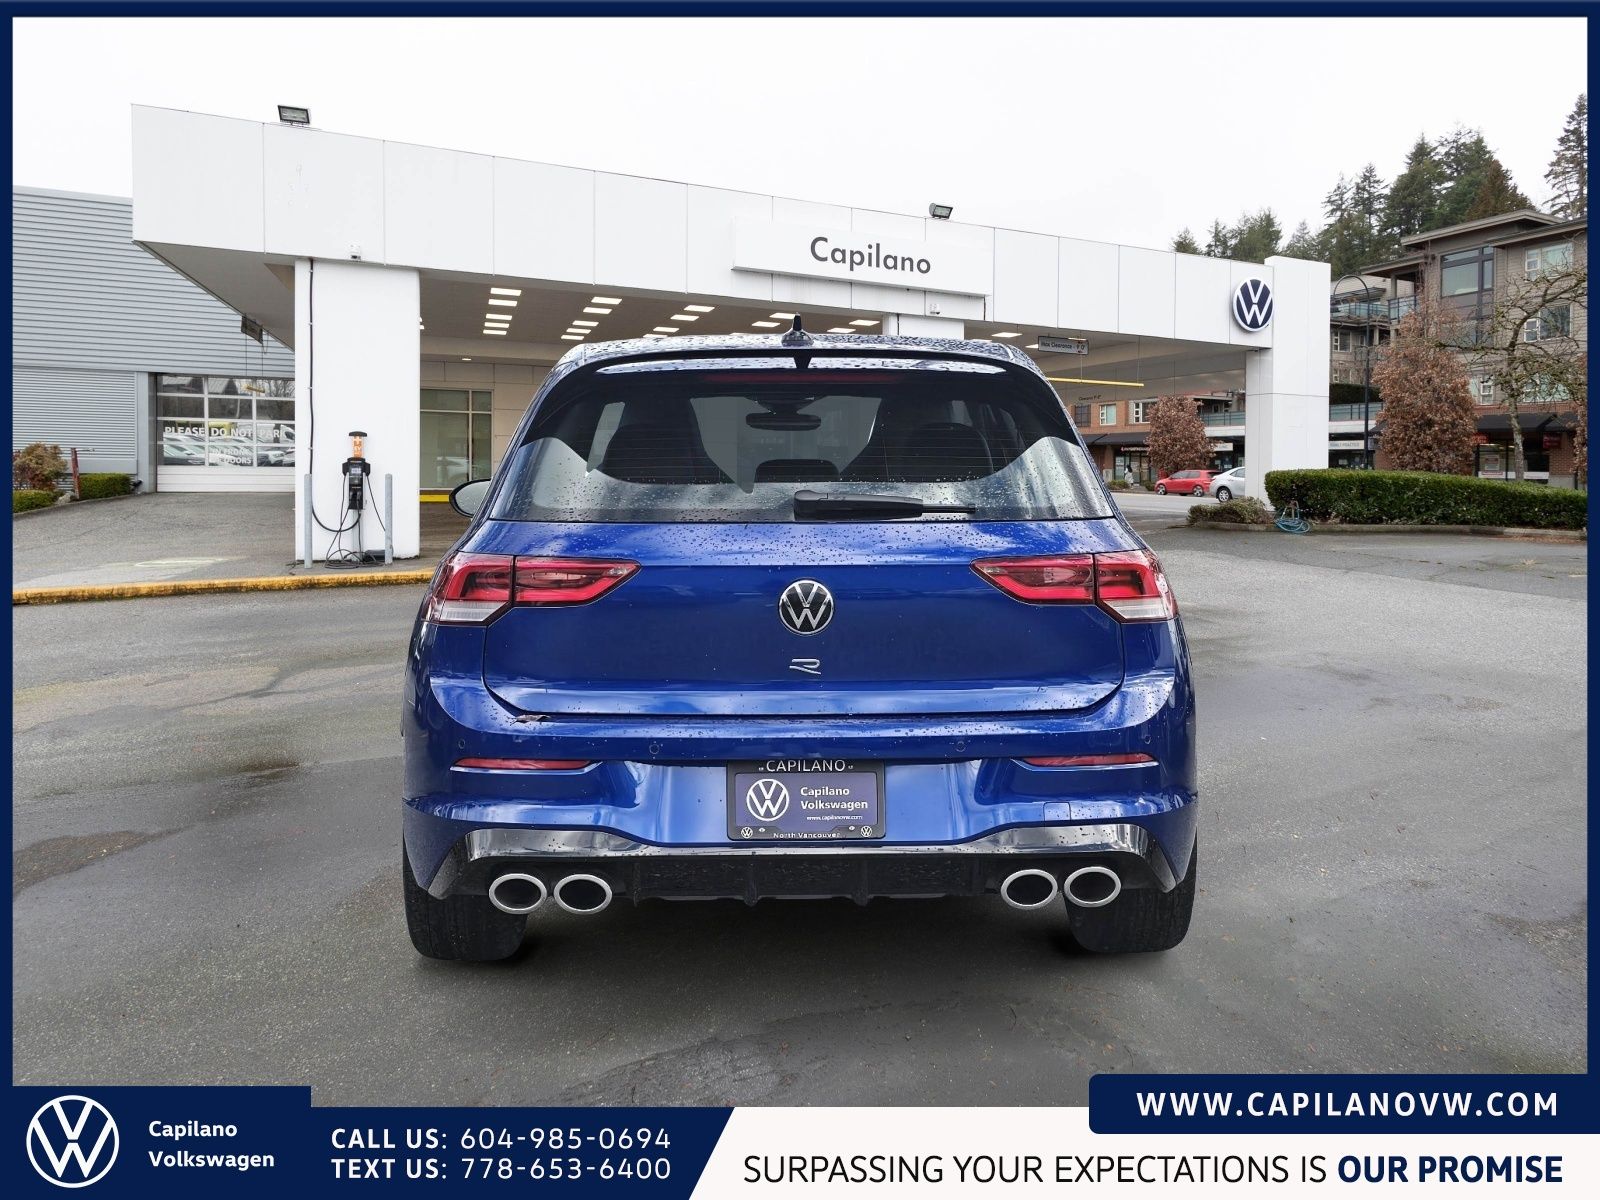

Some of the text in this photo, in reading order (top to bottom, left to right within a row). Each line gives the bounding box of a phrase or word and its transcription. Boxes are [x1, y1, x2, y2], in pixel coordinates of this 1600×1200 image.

[810, 236, 931, 274] Capilano
[164, 426, 206, 437] PLEASE
[211, 427, 226, 437] DO
[230, 428, 252, 438] NOT
[766, 759, 846, 772] CAPILANO
[800, 786, 850, 797] Capilano
[800, 799, 868, 811] Volkswagen
